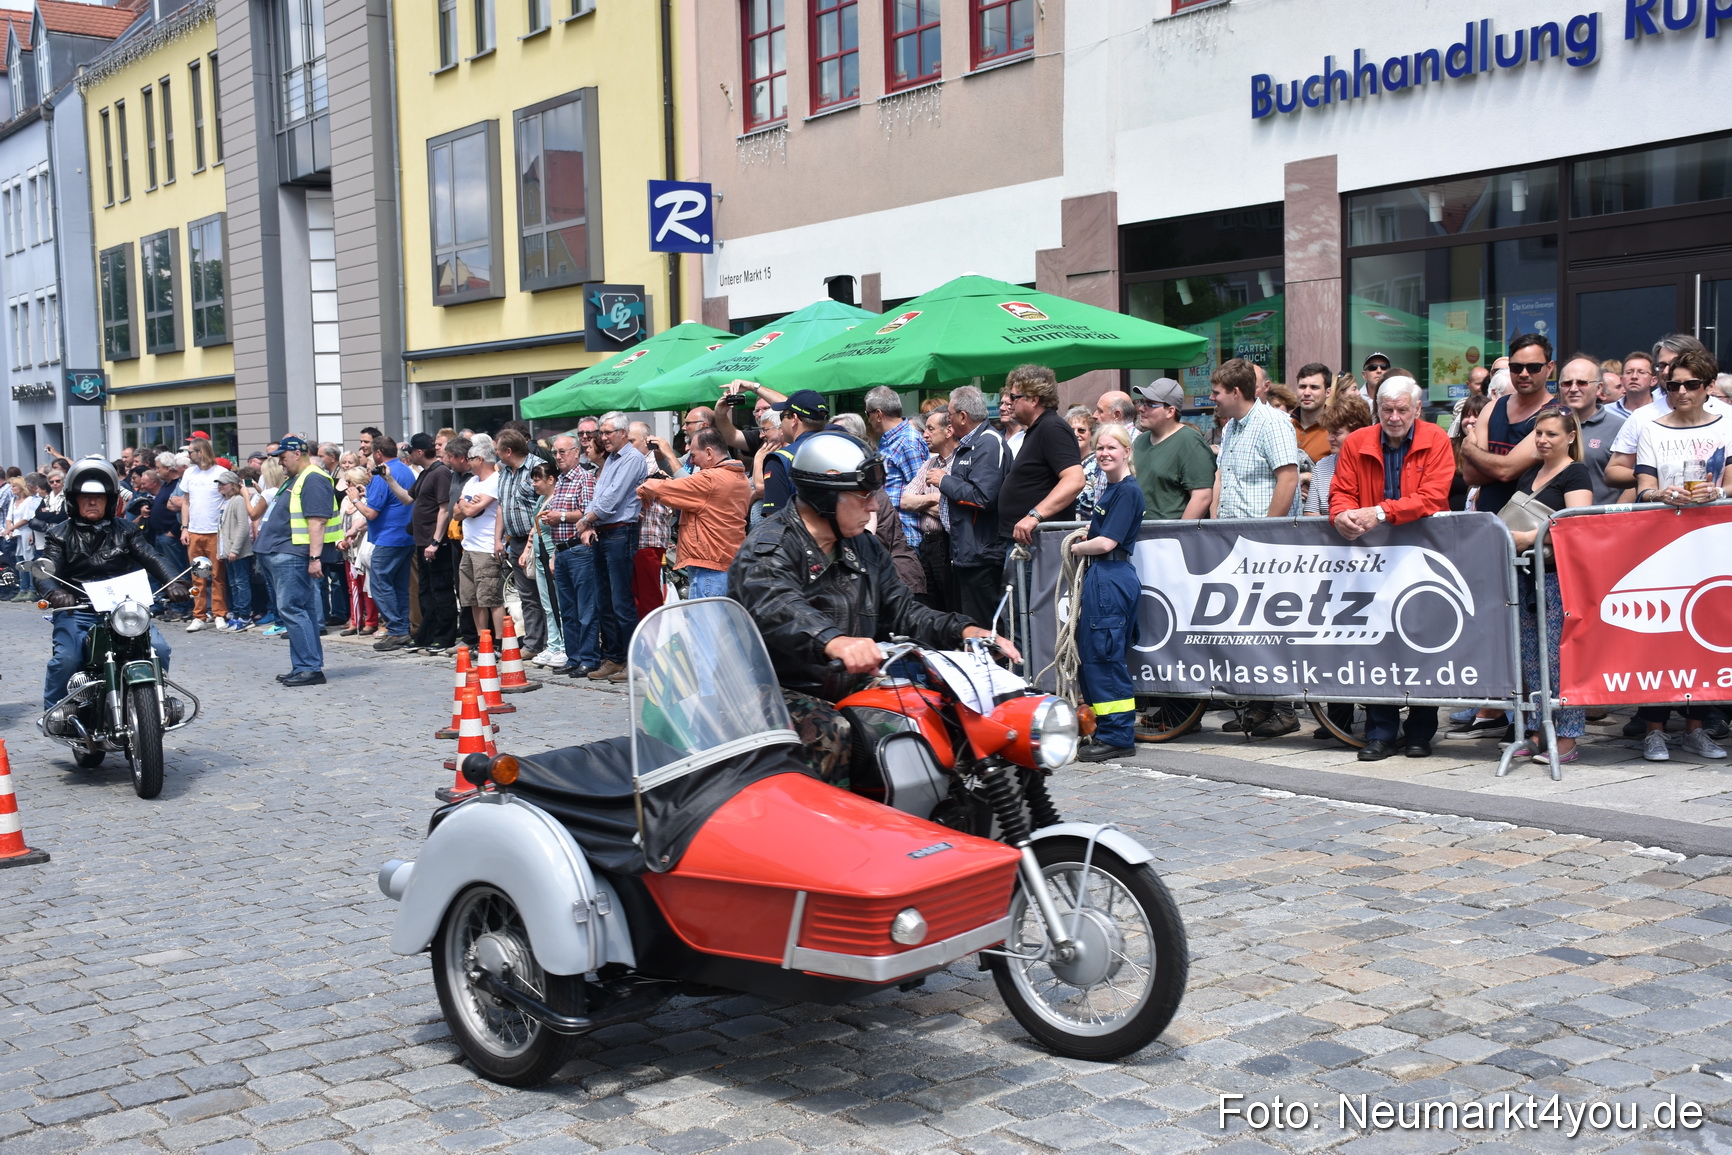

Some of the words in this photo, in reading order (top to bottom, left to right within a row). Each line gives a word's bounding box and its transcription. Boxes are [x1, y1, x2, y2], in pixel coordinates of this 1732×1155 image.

[1251, 11, 1601, 119] Buchhandlung
[719, 274, 742, 287] Unterer
[743, 269, 762, 283] Markt
[764, 266, 772, 279] 15
[610, 302, 633, 330] G2
[1001, 330, 1121, 344] Lammsbräu
[1238, 343, 1271, 354] GARTEN
[1188, 366, 1211, 377] MEER
[80, 378, 94, 394] G2
[1657, 438, 1715, 453] ALWAYS
[1232, 553, 1386, 575] Autoklassik
[1190, 579, 1377, 627] Dietz
[1184, 634, 1284, 646] BREITENBRUNN
[1603, 667, 1732, 692] www.a
